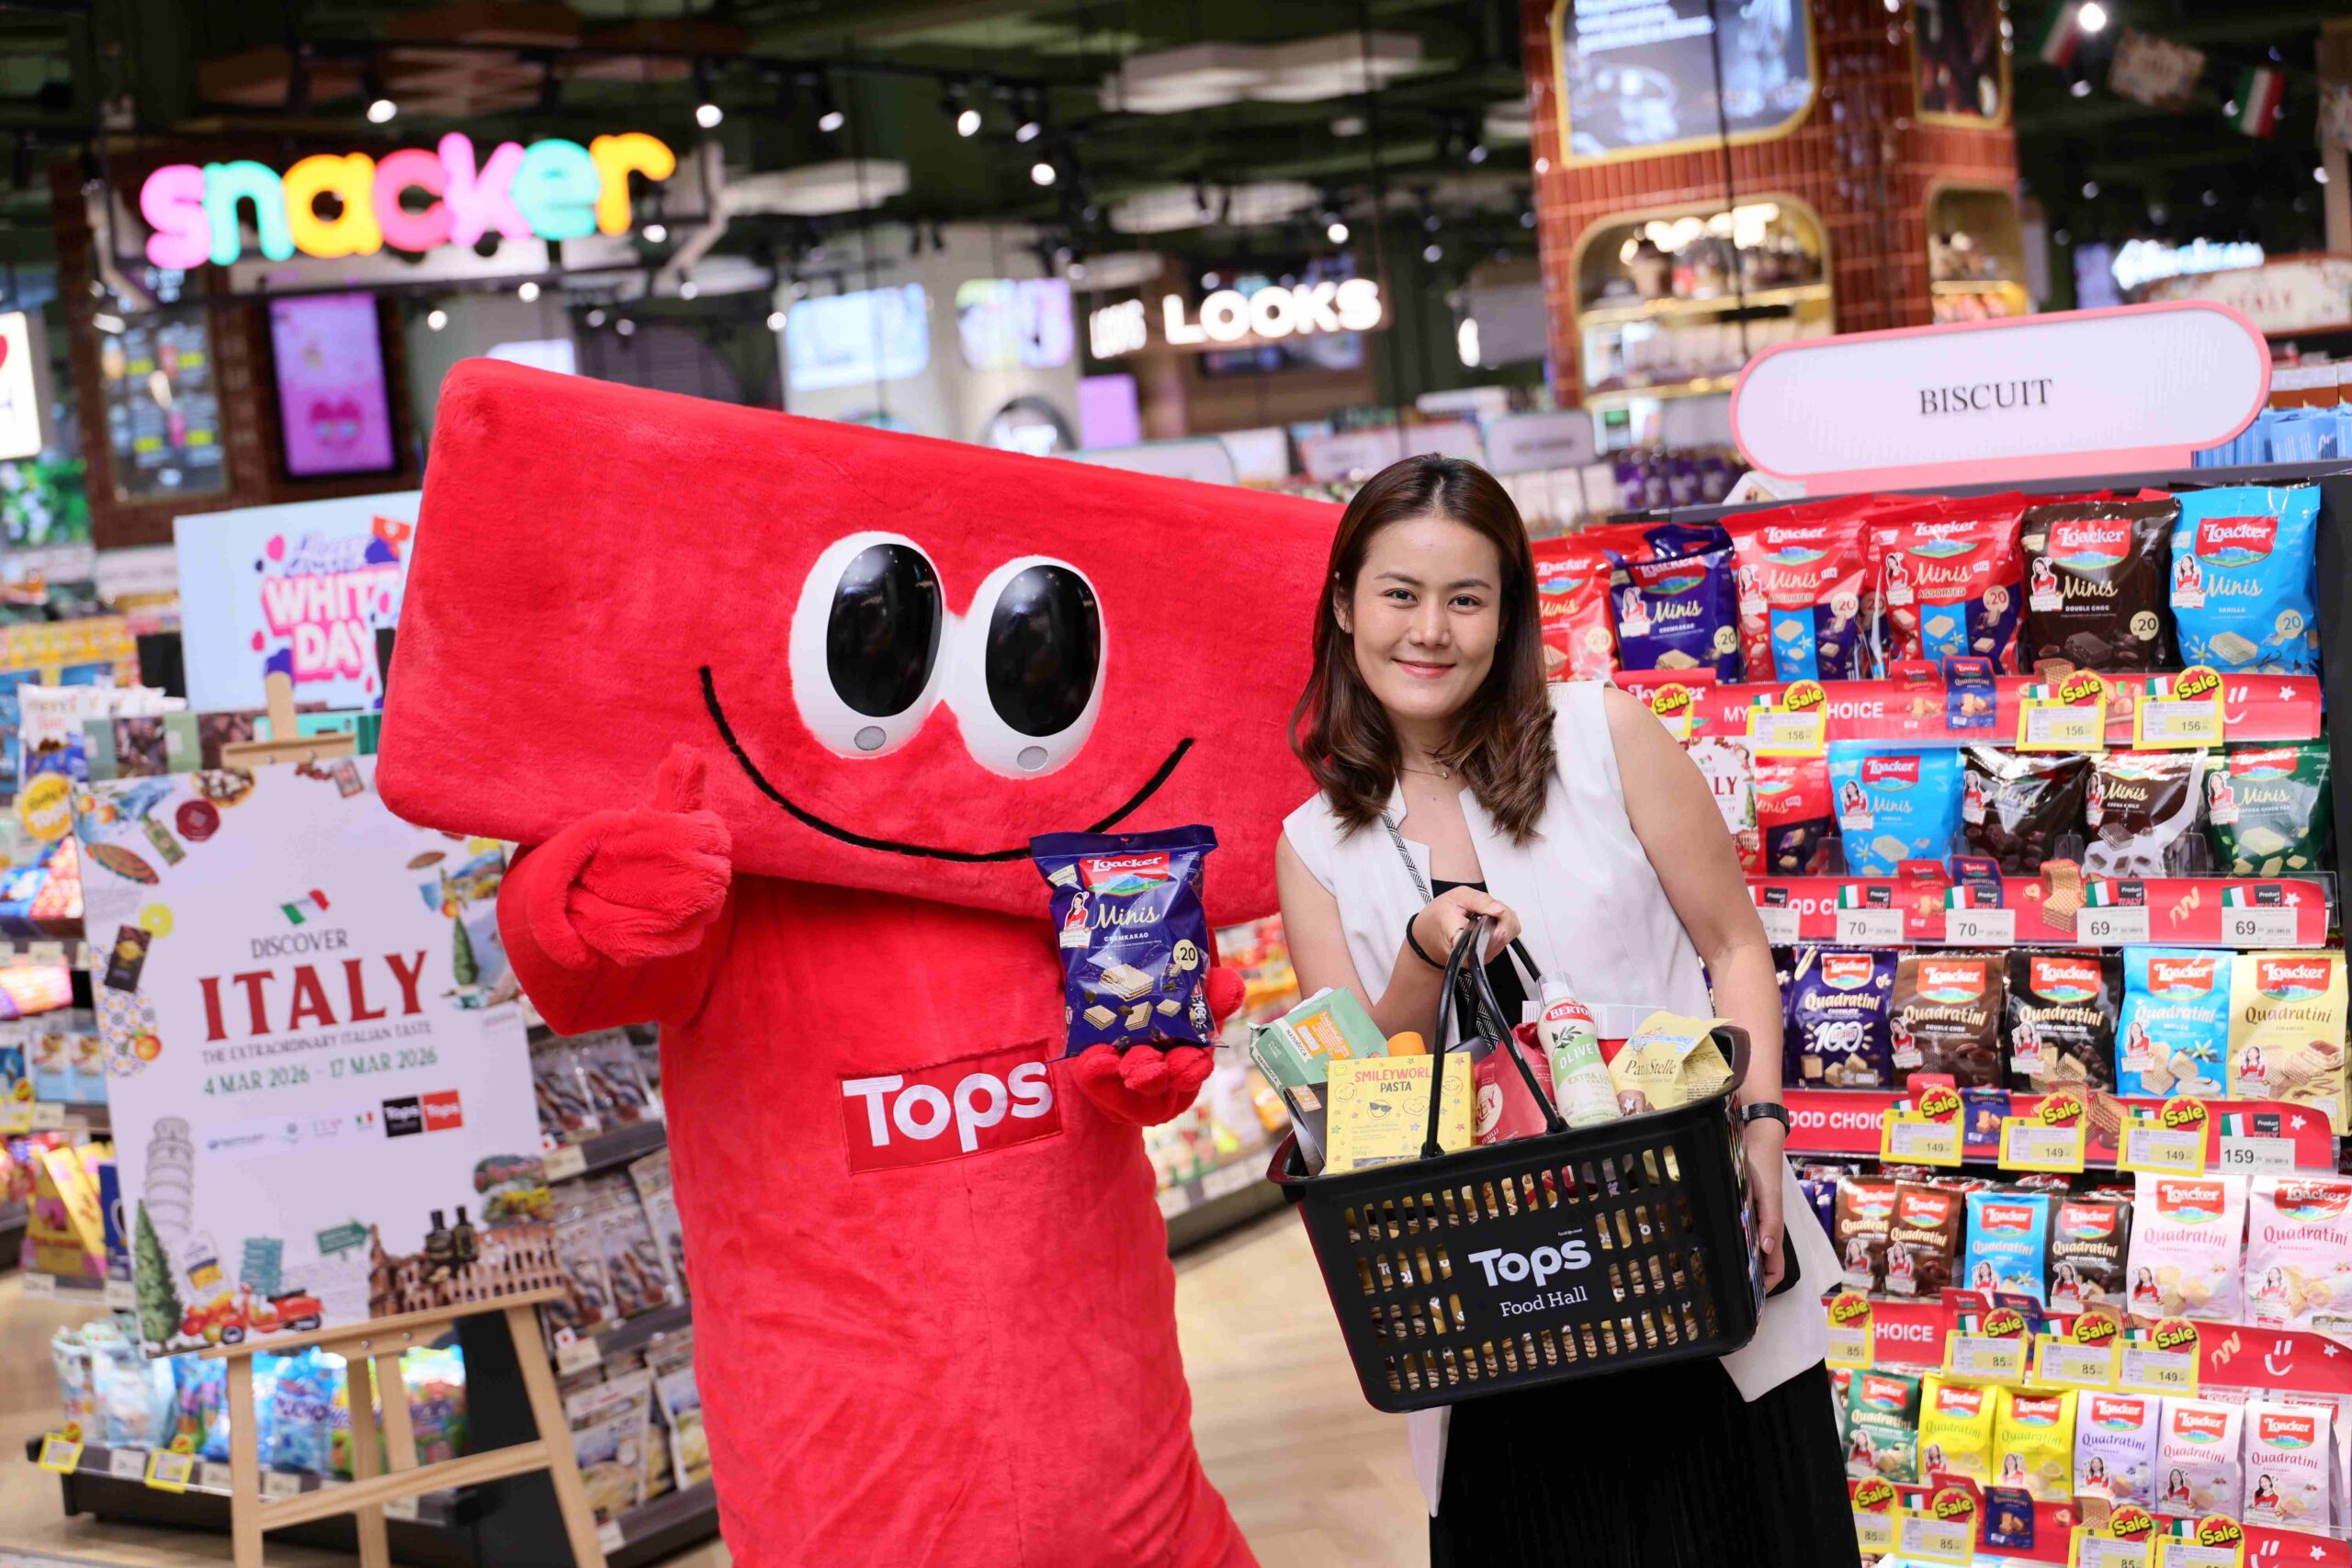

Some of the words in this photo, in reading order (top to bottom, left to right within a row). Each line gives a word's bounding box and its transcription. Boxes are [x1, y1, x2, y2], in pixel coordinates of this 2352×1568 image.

[141, 131, 676, 269] snacker
[1162, 278, 1382, 345] LOOKS
[1918, 378, 2053, 416] BISCUIT
[1764, 525, 1826, 543] Loacker
[1911, 521, 1978, 536] Loacker
[2057, 527, 2124, 547] Loacker
[2204, 523, 2271, 544] Loacker
[1763, 570, 1821, 591] Minis
[1913, 561, 1973, 586] Minis
[1917, 587, 1966, 599] ASSORTED
[2062, 575, 2119, 599] Minis
[2206, 573, 2263, 597] Minis
[1651, 600, 1702, 624] Minis
[292, 619, 369, 682] DAY
[2062, 678, 2101, 704] Sale
[2177, 674, 2219, 701] Sale
[1655, 694, 1689, 715] Sale
[1785, 689, 1825, 712] Sale
[1724, 707, 1747, 723] MY
[1826, 702, 1883, 718] HOICE
[2065, 726, 2084, 736] 156
[2181, 721, 2200, 731] 156
[1788, 731, 1804, 741] 156
[1868, 760, 1915, 773] Loacker
[2105, 783, 2148, 801] Minis
[2241, 786, 2290, 805] Minis
[1871, 795, 1912, 814] Minis
[1087, 856, 1162, 873] Loacker
[2121, 886, 2142, 895] Product
[2118, 897, 2143, 906] ITALY
[1091, 903, 1159, 929] Minis
[1103, 932, 1148, 942] CREMKAKAO
[1849, 921, 1866, 935] 70
[1959, 923, 1977, 936] 70
[2090, 921, 2110, 935] 69
[2235, 920, 2256, 935] 69
[251, 929, 348, 959] DISCOVER
[1925, 966, 1981, 984] Loacker
[2036, 962, 2096, 982] Loacker
[2154, 962, 2215, 981] Loacker
[2262, 962, 2325, 981] Loacker
[198, 949, 428, 1043] ITALY
[1804, 992, 1882, 1011] Quadratini
[1549, 1005, 1592, 1020] BERTO
[1904, 1005, 1988, 1027] Quadratini
[2019, 1005, 2104, 1027] Quadratini
[2134, 1005, 2217, 1024] Quadratini
[2245, 1006, 2333, 1025] Quadratini
[1559, 1043, 1593, 1069] OLIVE
[205, 1078, 215, 1096] 4
[220, 1069, 263, 1094] MAR
[268, 1063, 311, 1088] 2026
[330, 1057, 345, 1079] 17
[350, 1052, 391, 1075] MAR
[397, 1045, 438, 1069] 2026
[1257, 1055, 1278, 1083] NATURICCA
[1354, 1067, 1431, 1082] SMILEYWORL
[1380, 1081, 1412, 1093] PASTA
[842, 1061, 1054, 1153] Tops
[1922, 1096, 1959, 1118] Sale
[2042, 1102, 2083, 1125] Sale
[1789, 1111, 1826, 1128] OOD
[1829, 1111, 1883, 1130] CHOIC
[2165, 1105, 2205, 1129] Sale
[2256, 1119, 2278, 1127] Product
[1927, 1143, 1943, 1153] 149
[2045, 1148, 2064, 1157] 149
[2165, 1150, 2185, 1160] 149
[2223, 1149, 2255, 1164] 159
[2161, 1184, 2220, 1201] Loacker
[2286, 1186, 2346, 1202] Loacker
[2066, 1207, 2110, 1223] Loacker
[1891, 1227, 1948, 1247] Quadratini
[2143, 1227, 2227, 1247] Quadratini
[2264, 1225, 2348, 1247] Quadratini
[1972, 1240, 2035, 1257] Quadratini
[2052, 1240, 2119, 1258] Quadratini
[1468, 1239, 1591, 1286] Tops
[1499, 1295, 1545, 1317] Food
[1547, 1286, 1589, 1308] Hall
[1834, 1300, 1868, 1323] Sale
[1871, 1323, 1933, 1342] HOICE
[1985, 1316, 2024, 1338] Sale
[2077, 1321, 2116, 1344] Sale
[2156, 1326, 2197, 1349] Sale
[1847, 1346, 1860, 1357] 85
[2082, 1364, 2096, 1375] 85
[2159, 1371, 2178, 1382] 149
[1940, 1389, 1981, 1405] Loacker
[2015, 1398, 2058, 1414] Loacker
[2097, 1399, 2141, 1416] Loacker
[1851, 1409, 1911, 1430] Quadratini
[2178, 1411, 2222, 1429] Loacker
[2264, 1416, 2310, 1434] Loacker
[1926, 1420, 1981, 1439] Quadratini
[2001, 1430, 2063, 1447] Quadratini
[2082, 1432, 2146, 1451] Quadratini
[2164, 1443, 2226, 1464] Quadratini
[2252, 1451, 2319, 1471] Quadratini
[1858, 1485, 1894, 1507] Sale
[1936, 1498, 1973, 1518] Sale
[2112, 1515, 2153, 1538] Sale
[2202, 1525, 2240, 1546] Sale
